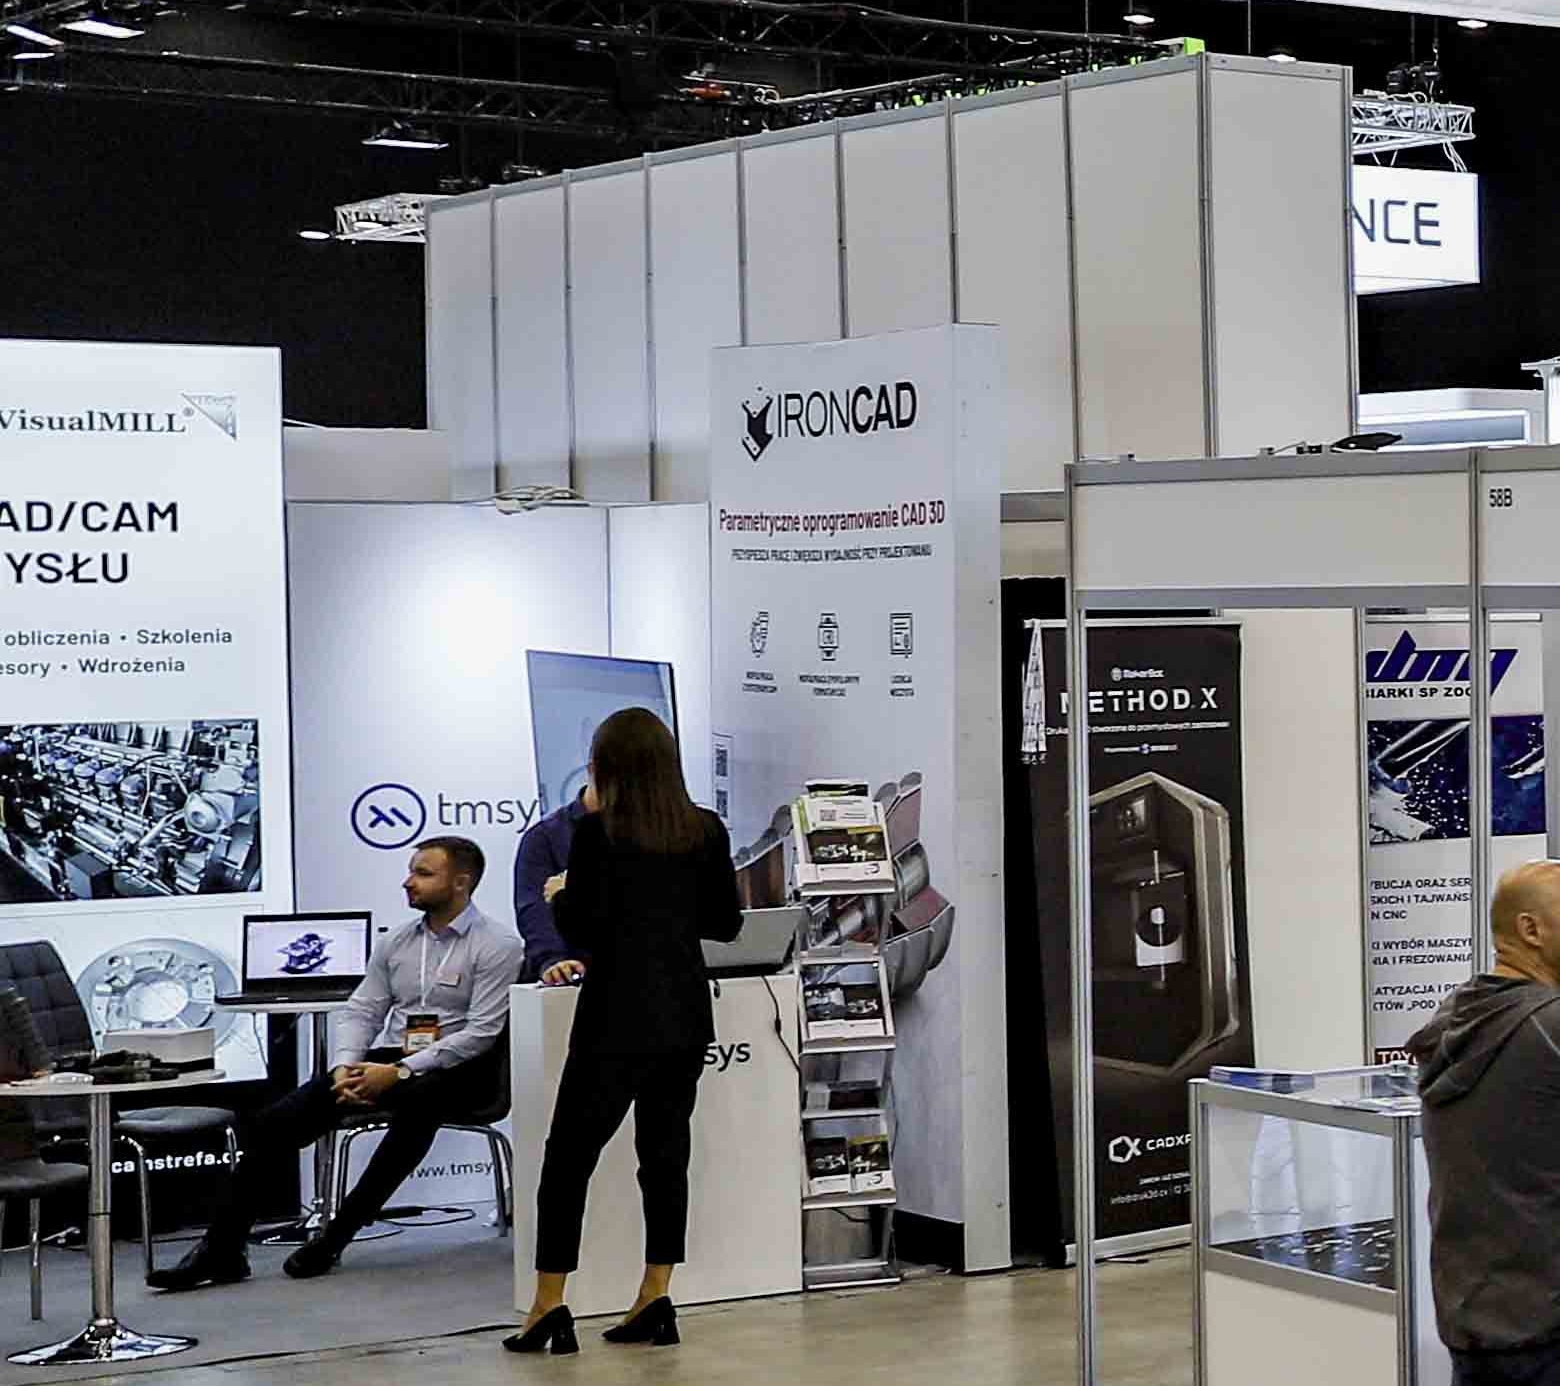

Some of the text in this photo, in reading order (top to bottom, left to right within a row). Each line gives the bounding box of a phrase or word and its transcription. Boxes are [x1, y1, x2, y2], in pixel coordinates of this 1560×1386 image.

[777, 381, 918, 438] IRONCAD
[1488, 488, 1513, 508] 58B
[719, 500, 946, 537] Parametryczne oprogramowanie CAD 3D
[4, 628, 233, 647] obliczenia Szkolenia
[78, 657, 186, 674] Wdrożenia
[1199, 686, 1218, 710] X
[1418, 687, 1439, 698] SP
[1371, 879, 1413, 891] BUCJA
[1415, 877, 1447, 888] ORAZ
[1383, 909, 1408, 920] CNC
